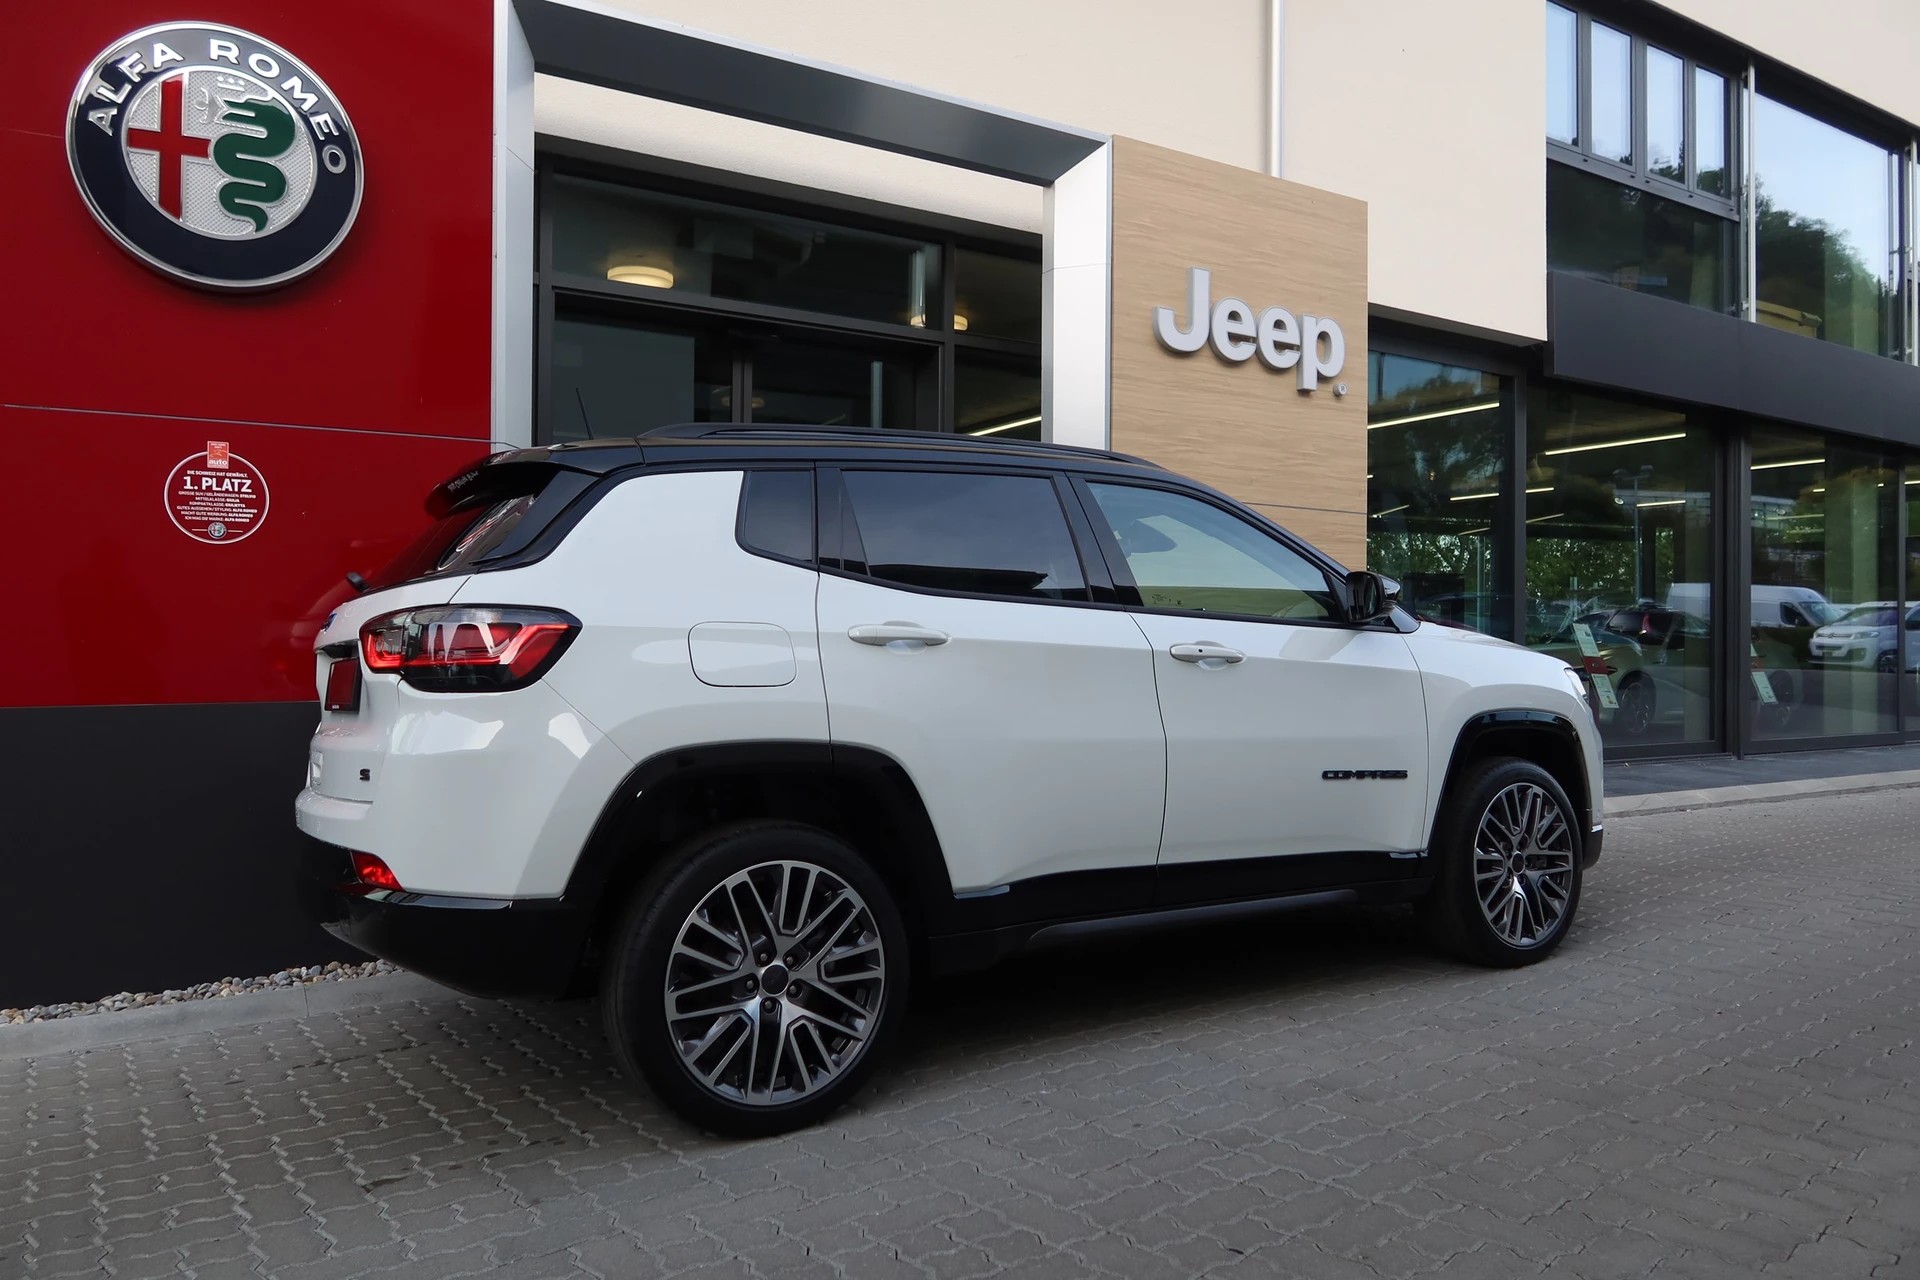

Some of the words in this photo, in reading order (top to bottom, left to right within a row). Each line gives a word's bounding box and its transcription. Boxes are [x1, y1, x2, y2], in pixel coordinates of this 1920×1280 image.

[87, 41, 185, 137] ALFA
[208, 37, 348, 175] ROMEO
[1153, 265, 1346, 393] Jeep
[183, 476, 198, 490] 1.
[201, 477, 252, 493] PLATZ
